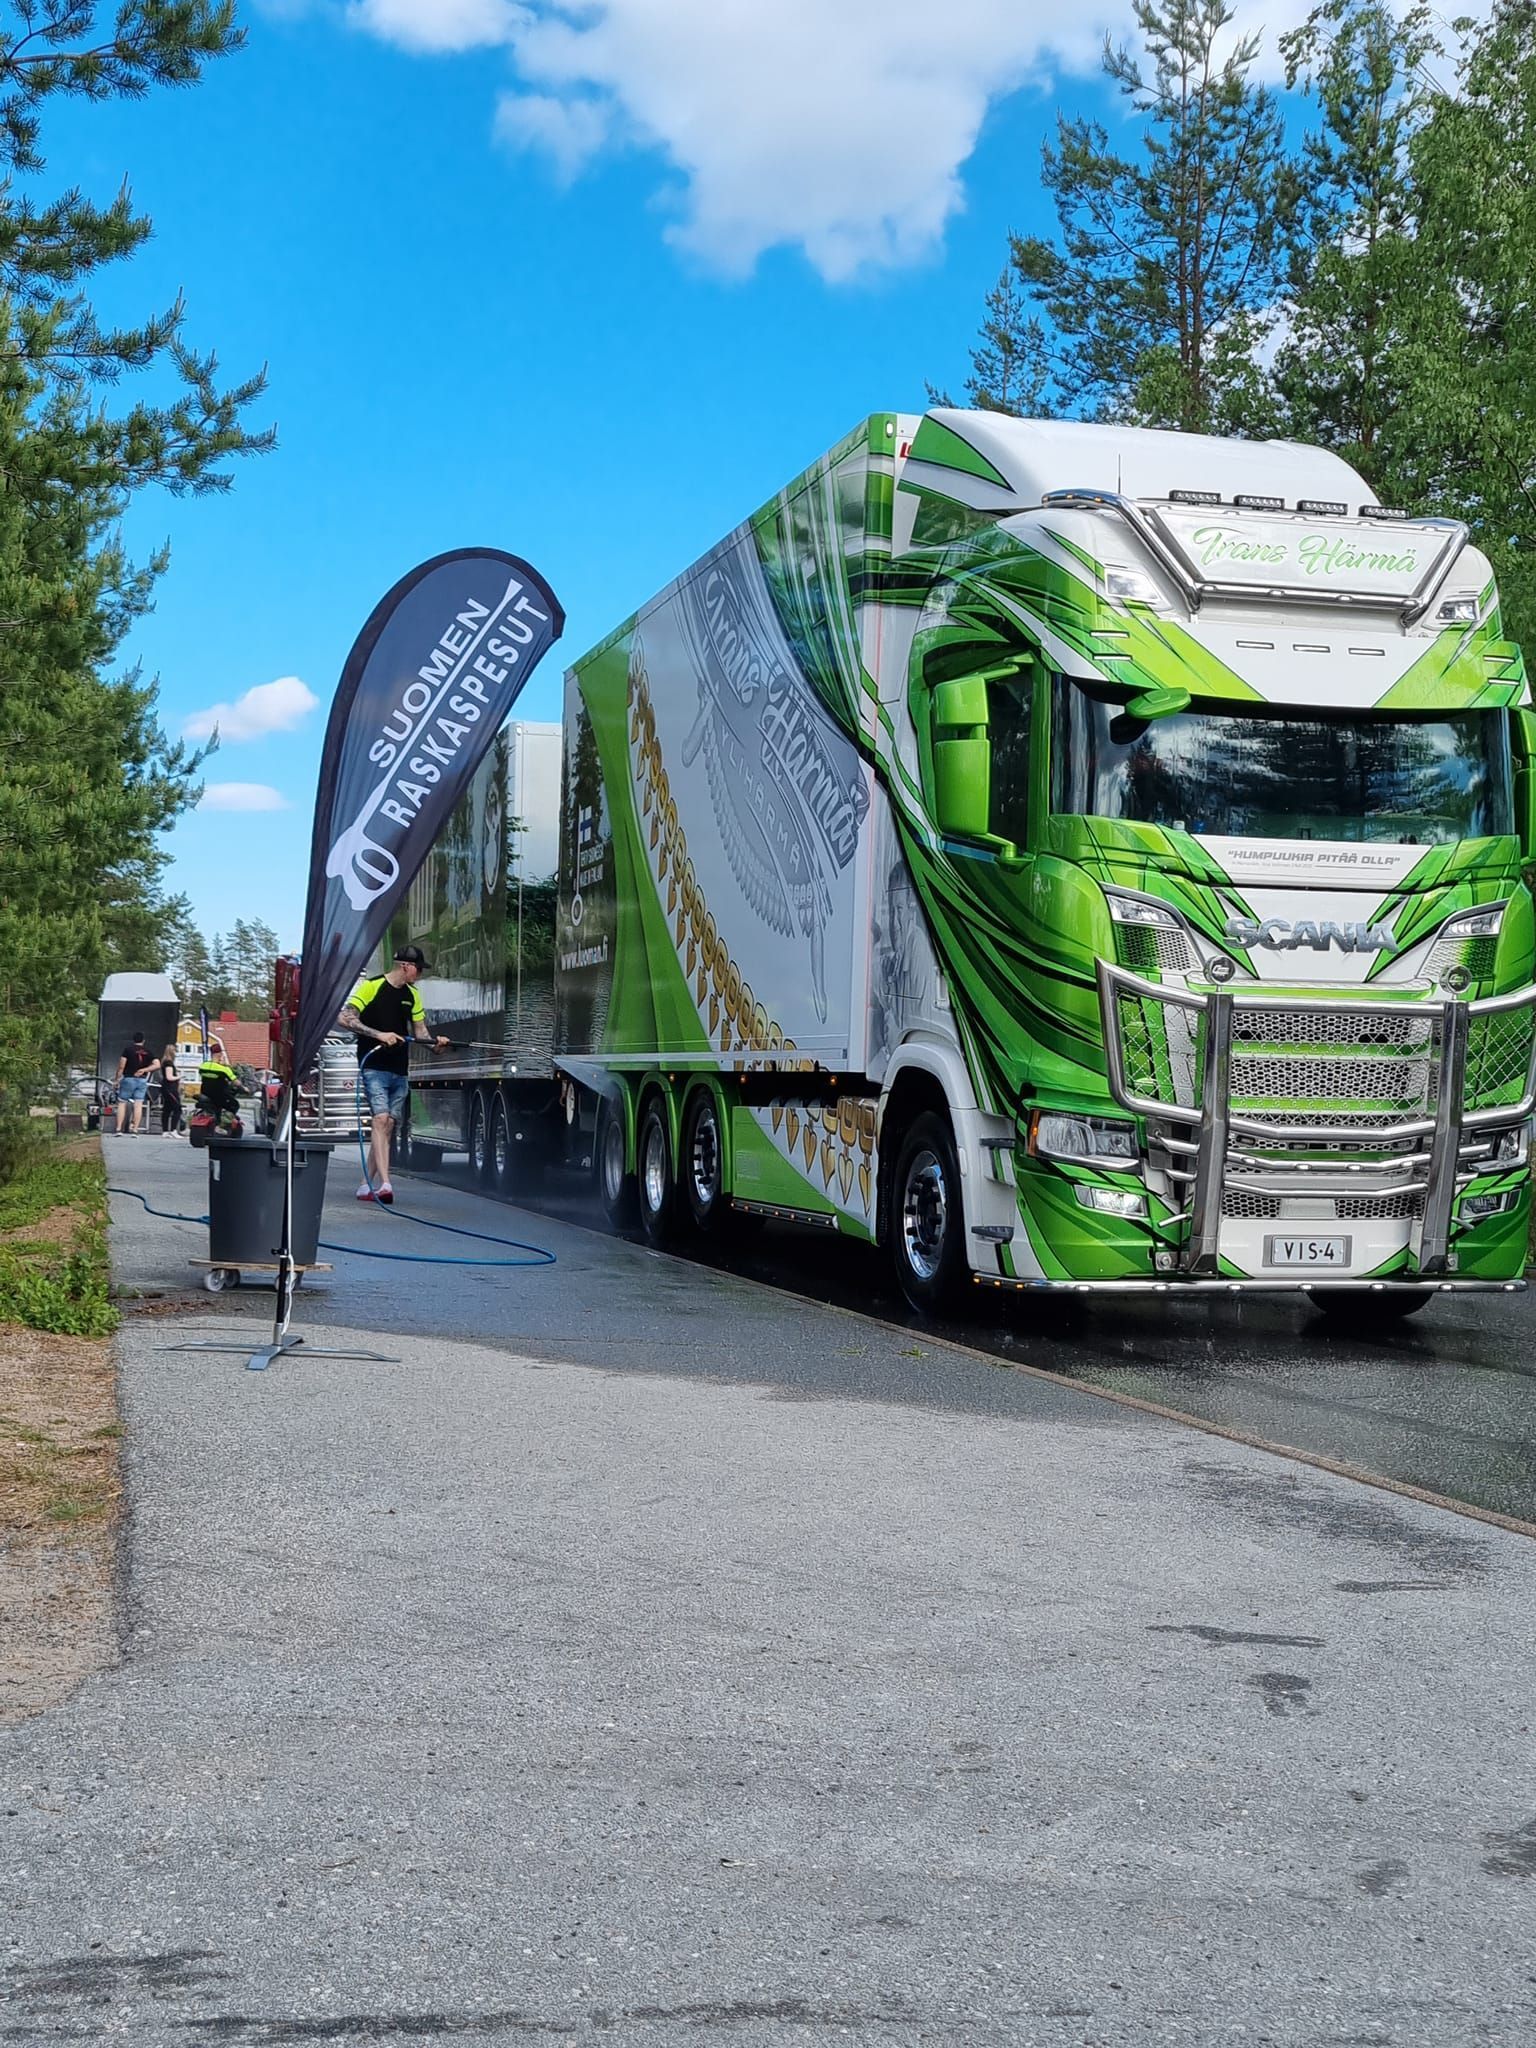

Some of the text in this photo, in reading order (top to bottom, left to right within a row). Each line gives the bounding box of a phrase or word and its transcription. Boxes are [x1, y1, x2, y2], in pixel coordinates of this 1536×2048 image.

[1192, 526, 1418, 575] Trans Härmä
[369, 598, 491, 768] SUOMEN
[380, 596, 548, 828] RASKASPESUT
[705, 570, 856, 857] Trans Härmä
[1317, 852, 1357, 864] PITÄÄ
[1223, 917, 1400, 954] SCANIA
[1284, 1242, 1334, 1260] VIS-4
